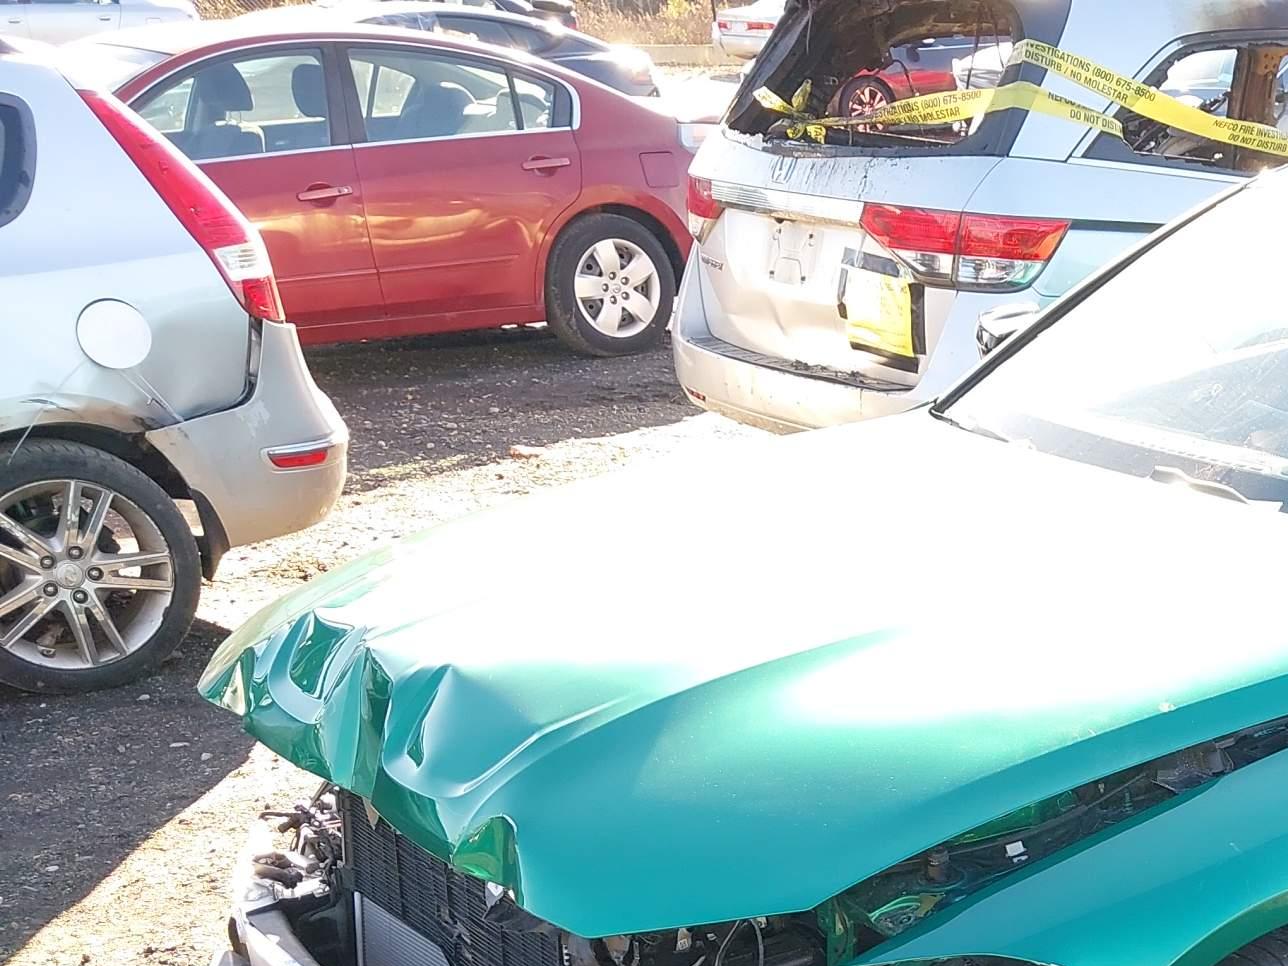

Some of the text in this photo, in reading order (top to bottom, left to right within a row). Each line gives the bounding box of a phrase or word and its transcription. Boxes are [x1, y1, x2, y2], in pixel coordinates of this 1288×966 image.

[1024, 49, 1062, 72] DISTURB
[1070, 69, 1082, 81] NO
[1083, 76, 1128, 104] MOLESTAR
[1092, 66, 1114, 84] (800)
[1115, 77, 1156, 102] 675-8500
[920, 98, 941, 111] (800)
[942, 90, 981, 105] 675-8500
[920, 107, 960, 123] MOLESTAR
[1069, 109, 1081, 121] DO
[1083, 113, 1101, 125] NOT
[1213, 120, 1238, 132] NEFCO
[1238, 125, 1255, 136] FIRE
[1228, 133, 1240, 141] DO
[1240, 136, 1256, 146] NOT
[1256, 138, 1288, 153] DISTURB
